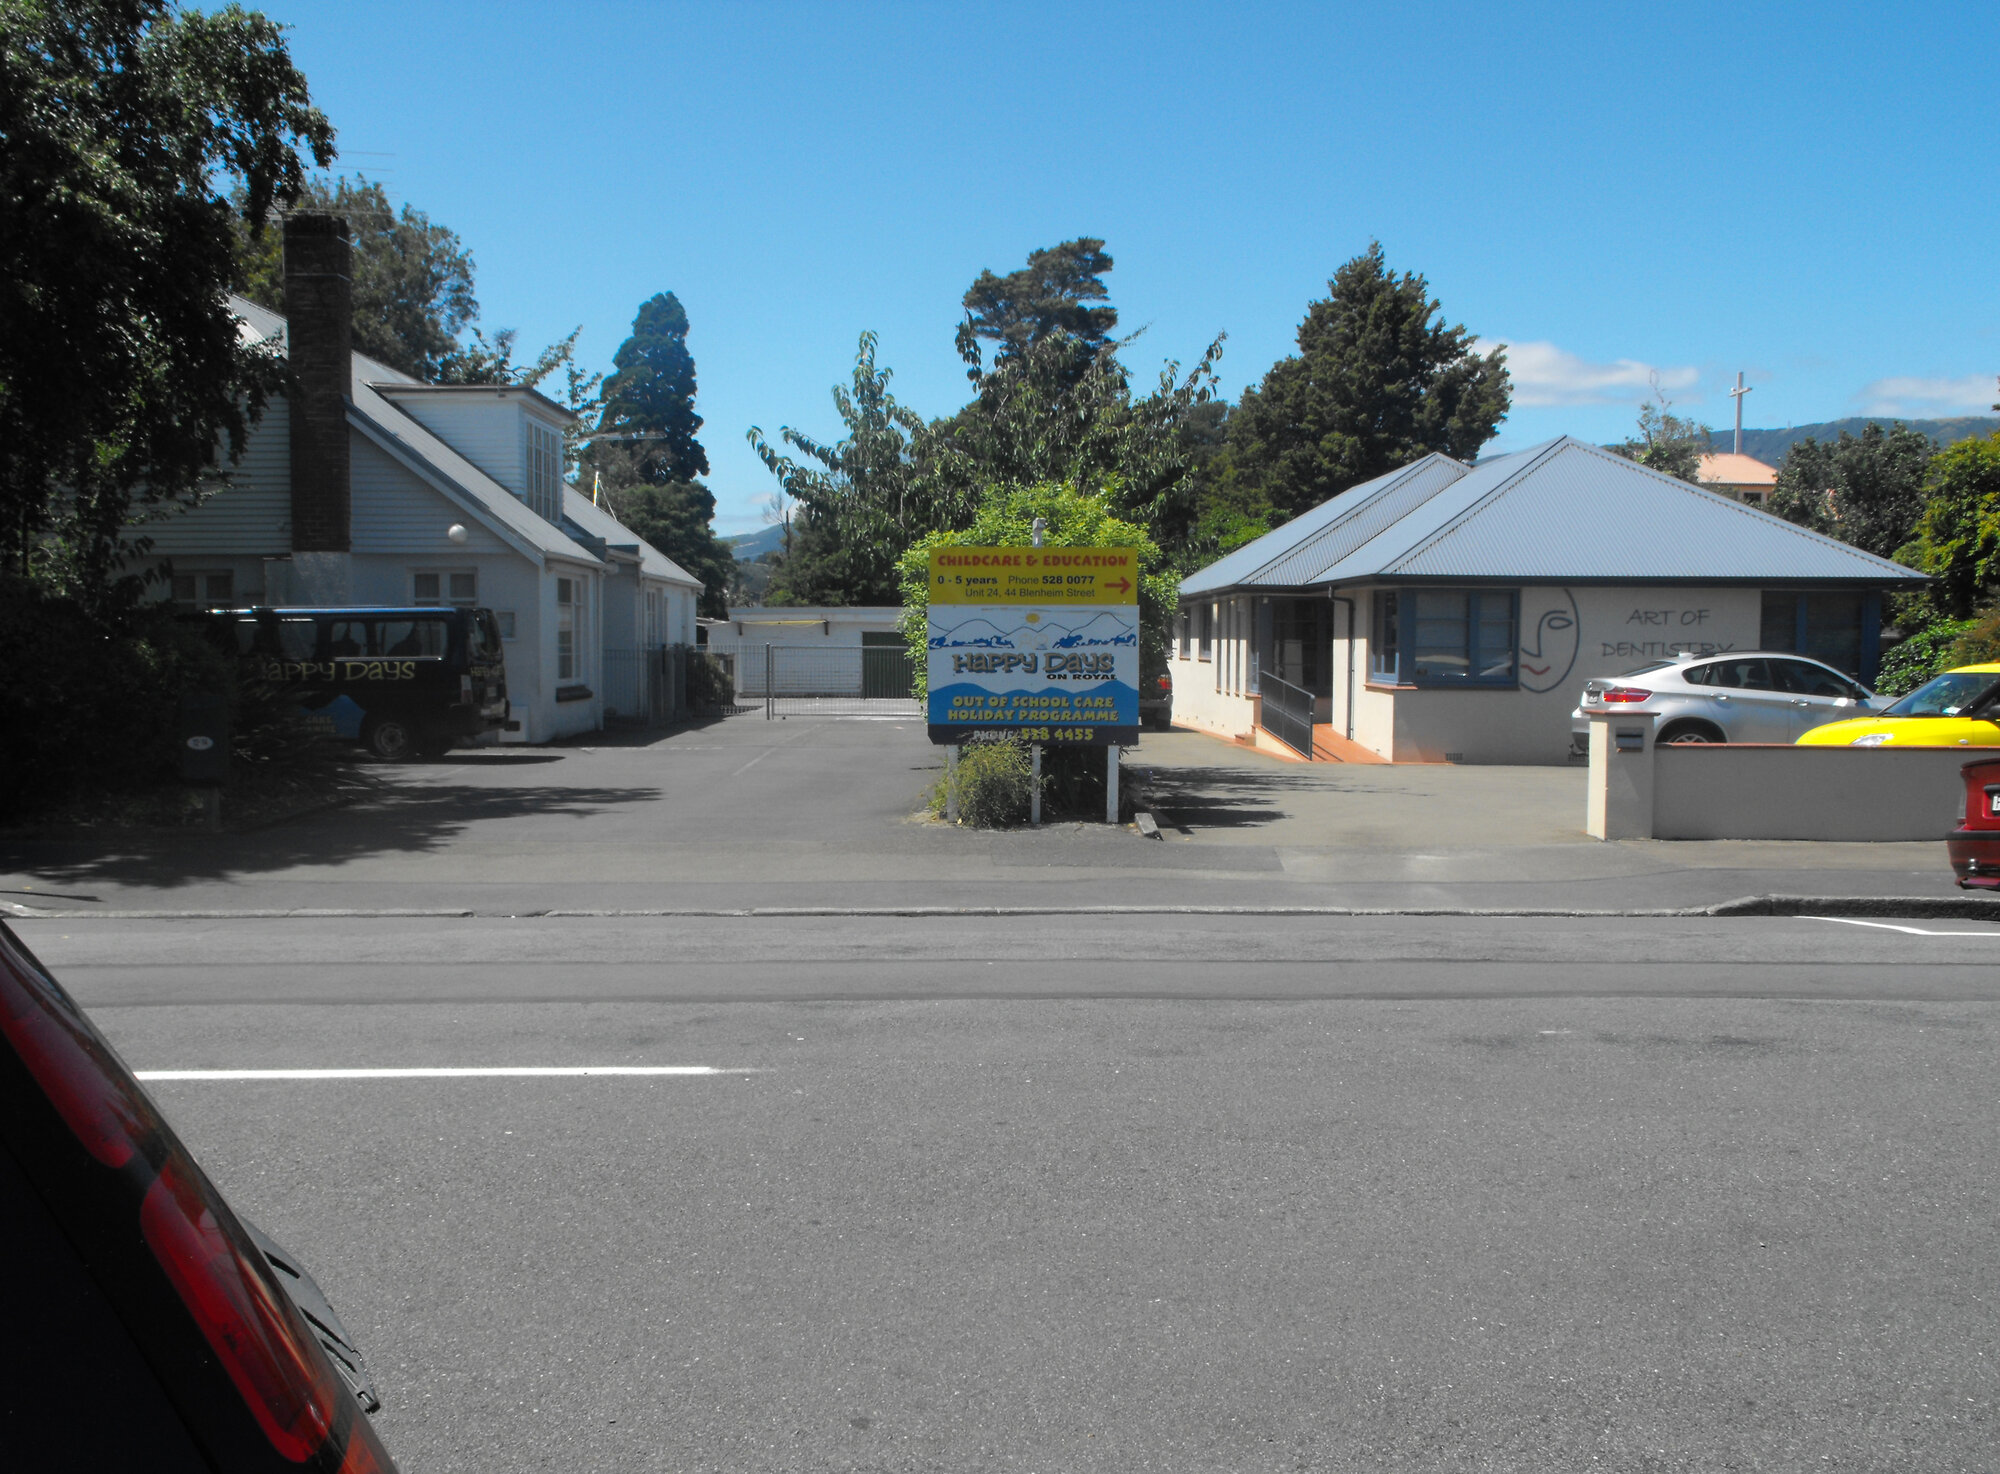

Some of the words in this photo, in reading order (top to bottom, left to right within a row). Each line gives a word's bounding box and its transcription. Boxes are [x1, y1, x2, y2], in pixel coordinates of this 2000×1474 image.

[938, 555, 1021, 567] CHILDCARE
[1026, 555, 1038, 567] &
[1043, 555, 1129, 567] EDUCATION
[937, 575, 945, 585] 0
[955, 575, 963, 585] 5
[966, 576, 998, 588] years
[1008, 575, 1039, 585] Phone
[1042, 575, 1064, 585] 528
[1067, 575, 1096, 585] 0077
[965, 588, 985, 598] Unit
[986, 588, 1001, 599] 24,
[1005, 588, 1017, 598] 44
[1019, 588, 1064, 598] Blenheim
[1066, 588, 1096, 598] Street
[1625, 609, 1677, 625] ART
[1680, 609, 1712, 626] OF
[1046, 673, 1070, 681] ON
[1072, 673, 1118, 681] ROYAL
[952, 696, 984, 708] OUT
[988, 696, 1008, 708] OF
[1012, 696, 1070, 708] SCHOOL
[1073, 696, 1115, 708] CARE
[948, 709, 1015, 722] HOLIDAY
[1018, 709, 1119, 722] PROGRAMME
[1054, 727, 1094, 741] 4455
